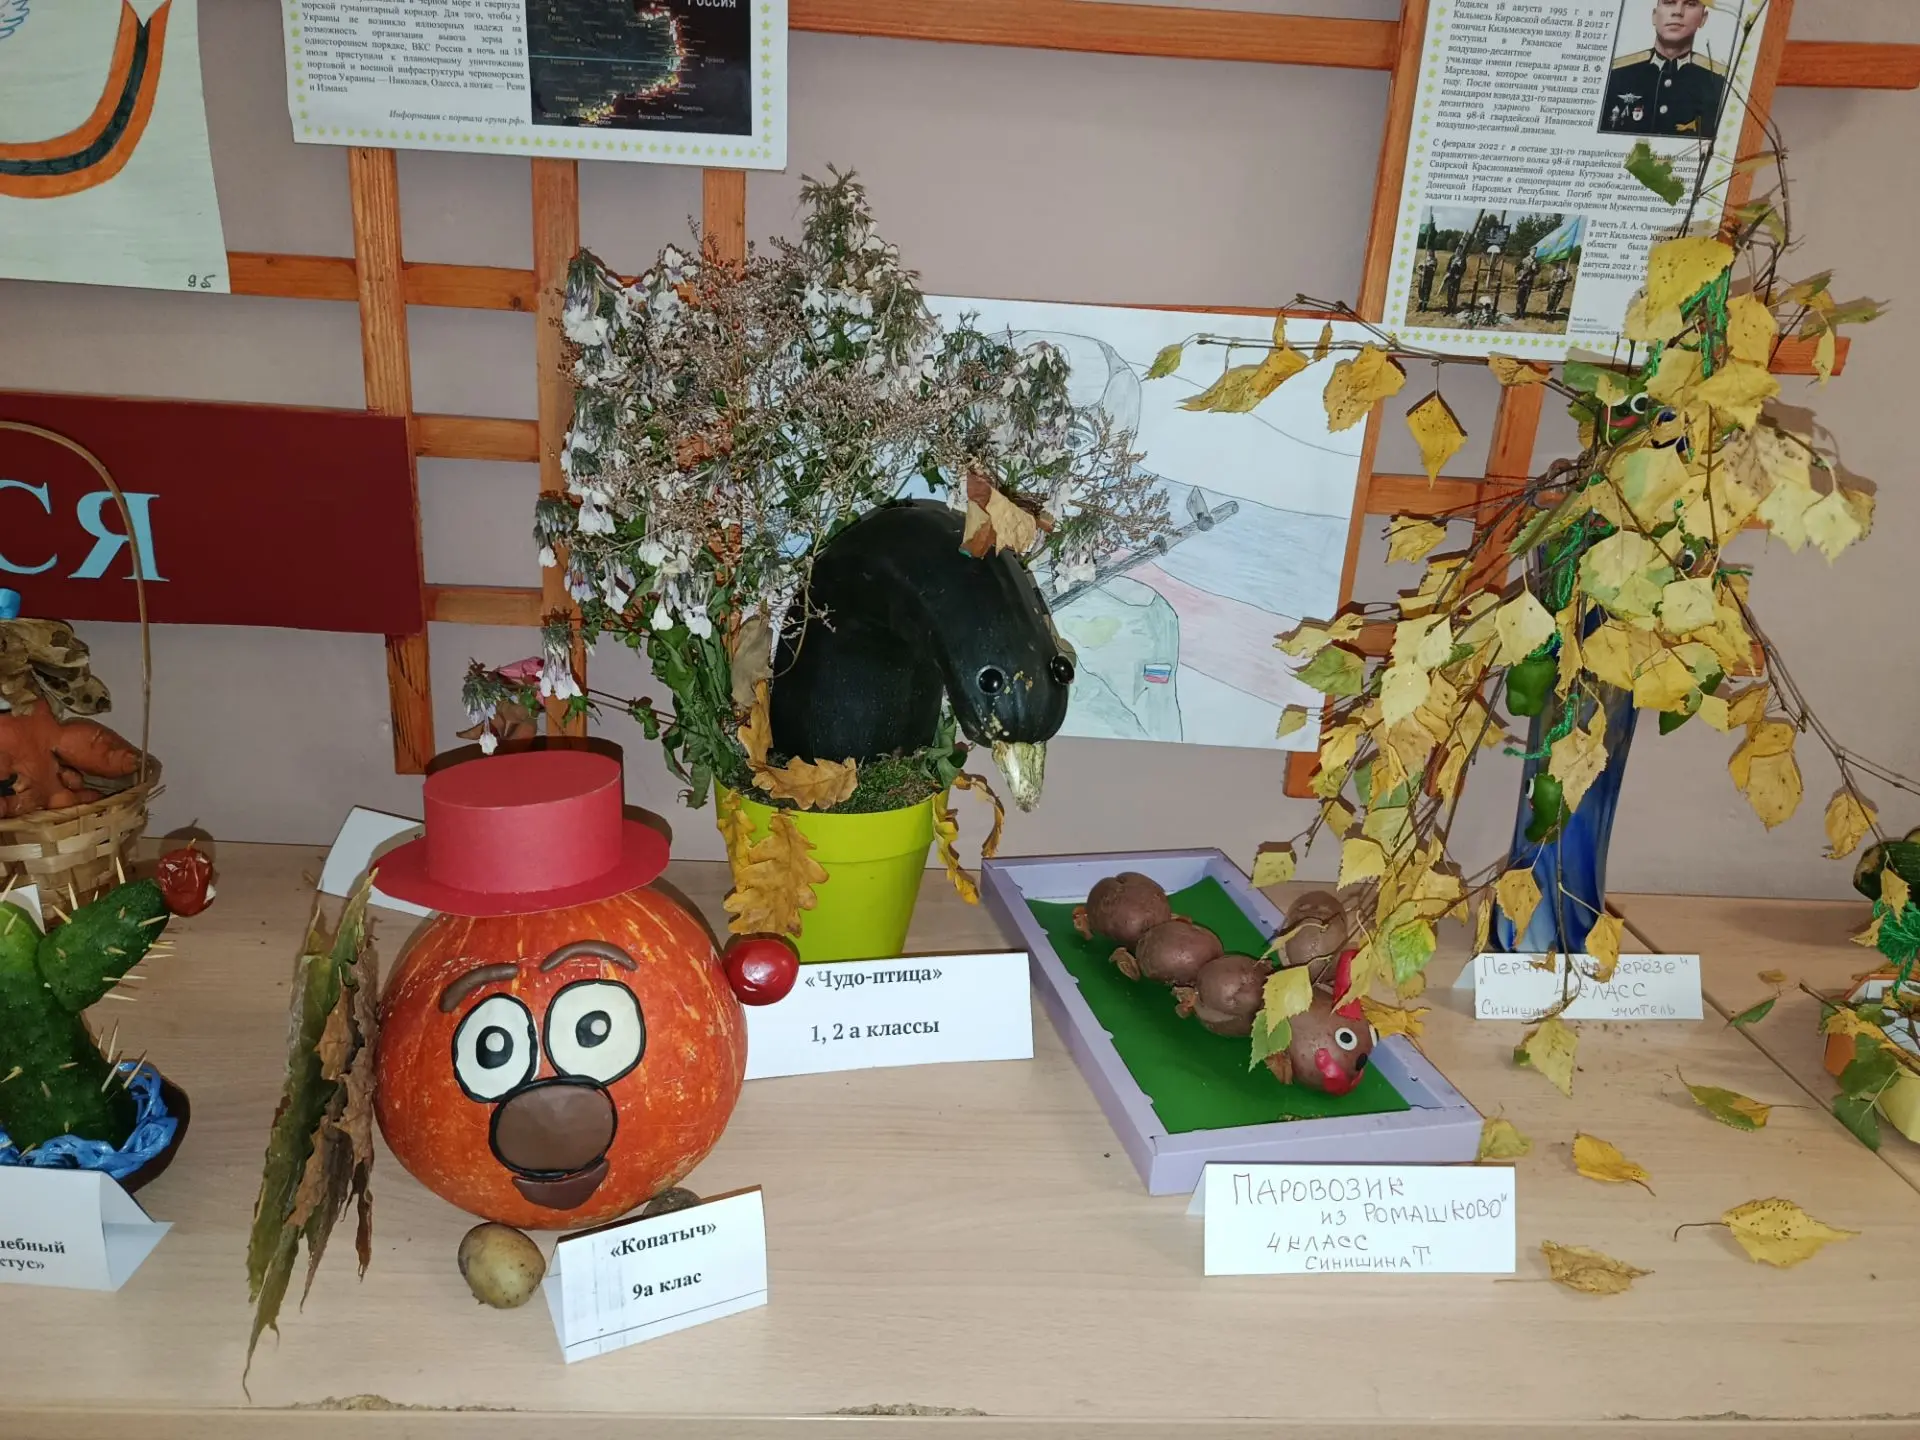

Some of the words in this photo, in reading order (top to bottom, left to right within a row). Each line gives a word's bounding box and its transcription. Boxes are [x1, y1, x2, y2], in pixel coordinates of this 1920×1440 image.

[301, 2, 336, 11] морской
[340, 4, 400, 15] гуманитарный
[443, 8, 460, 18] Для
[487, 12, 512, 20] чтобы
[1453, 10, 1493, 20] Кильмезь
[1495, 13, 1539, 24] Кировской
[1512, 4, 1543, 14] августа
[1549, 6, 1568, 16] 1995
[302, 12, 340, 23] Украины
[368, 17, 406, 27] возникло
[415, 21, 465, 31] иллюзорных
[474, 23, 503, 33] надежд
[1451, 23, 1487, 32] окончил
[303, 26, 357, 35] возможность
[372, 30, 424, 40] организации
[304, 37, 368, 48] одностороннем
[411, 42, 431, 52] ВКС
[435, 44, 463, 53] России
[1450, 34, 1487, 44] поступил
[1521, 37, 1563, 48] Рязанское
[1576, 43, 1608, 51] высшее
[335, 51, 384, 61] приступили
[307, 60, 346, 71] портовой
[360, 64, 394, 73] военной
[397, 65, 465, 78] инфраструктуры
[468, 71, 525, 80] черноморских
[1444, 65, 1490, 77] Маргелова,
[1495, 71, 1528, 80] которое
[1533, 73, 1568, 82] окончил
[1486, 59, 1512, 67] имени
[1515, 61, 1551, 71] генерала
[1553, 63, 1581, 72] армии
[308, 73, 337, 82] портов
[338, 73, 376, 84] Украины
[430, 78, 462, 88] Одесса,
[1466, 78, 1492, 87] После
[1494, 82, 1539, 91] окончания
[1541, 85, 1578, 93] училища
[1581, 87, 1600, 95] стал
[1441, 89, 1493, 99] командиром
[1438, 100, 1484, 109] десантного
[1493, 103, 1531, 112] ударного
[1540, 104, 1596, 116] Костромского
[1436, 121, 1520, 132] воздушно-десантной
[1437, 111, 1461, 119] полка
[1490, 113, 1541, 123] гвардейской
[1544, 116, 1594, 127] Ивановской
[1441, 139, 1476, 149] февраля
[1550, 147, 1575, 156] 331-го
[1431, 151, 1525, 163] парашютно-десантного
[1526, 157, 1550, 165] полка
[1572, 159, 1622, 169] гвардейской
[1429, 160, 1468, 170] Свирской
[1547, 168, 1575, 177] ордена
[1579, 168, 1614, 180] Кутузова
[1427, 171, 1469, 181] принимал
[1472, 174, 1504, 183] участие
[1515, 177, 1572, 187] спецоперации
[1425, 181, 1466, 191] Донецкой
[1471, 183, 1512, 193] Народных
[1566, 189, 1593, 198] Погиб
[1597, 192, 1612, 201] при
[1424, 192, 1452, 201] задачи
[1463, 195, 1487, 204] марта
[1573, 202, 1608, 210] орденом
[1609, 202, 1648, 213] Мужества
[1598, 221, 1619, 229] честь
[1586, 240, 1617, 249] области
[1582, 261, 1611, 270] августа
[804, 966, 943, 991] «Чудо-птица»
[810, 1025, 827, 1044] 1,
[832, 1023, 845, 1040] 2
[849, 1027, 861, 1039] а
[866, 1020, 940, 1038] классы
[609, 1222, 718, 1258] «Копатыч»
[1266, 1231, 1281, 1253] 4
[632, 1283, 654, 1301] 9а
[659, 1271, 703, 1294] клас
